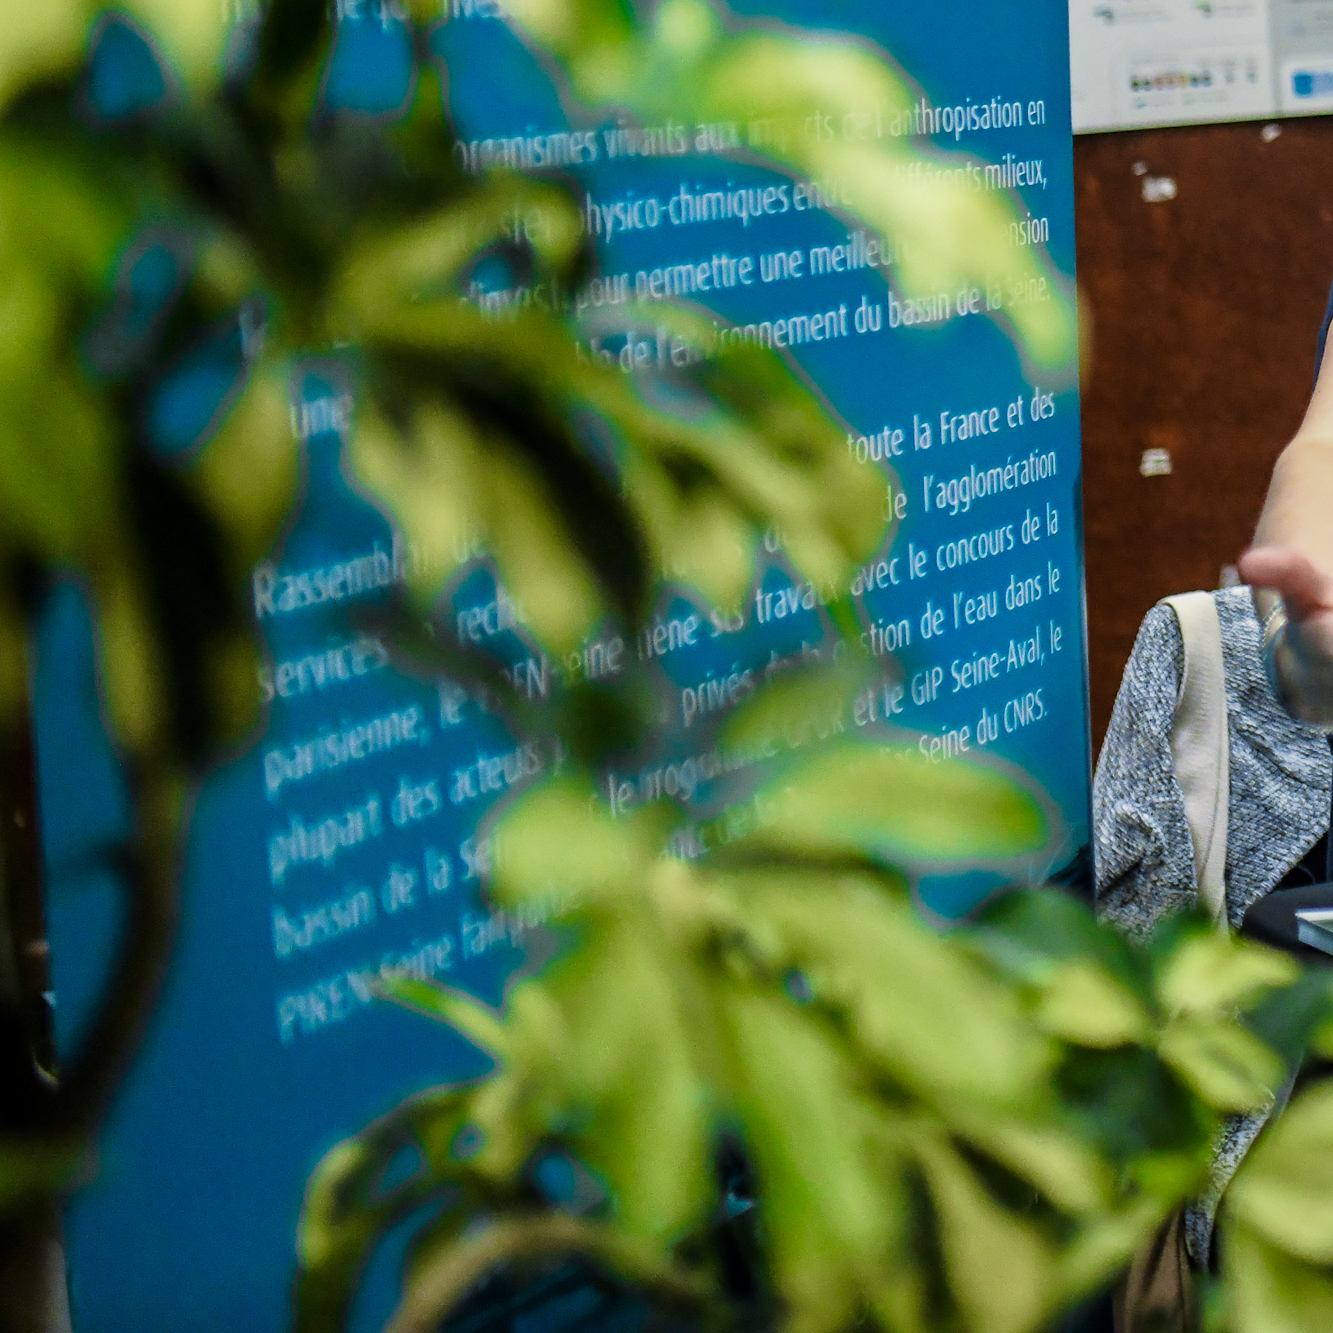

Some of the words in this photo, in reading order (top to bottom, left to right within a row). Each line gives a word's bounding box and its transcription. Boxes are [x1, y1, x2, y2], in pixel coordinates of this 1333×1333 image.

[1026, 98, 1046, 127] en
[584, 179, 789, 244] hysico-chimiques
[984, 153, 1048, 191] milieux,
[635, 252, 754, 300] permettre
[760, 247, 804, 284] une
[854, 295, 883, 335] du
[888, 280, 950, 328] bassin
[956, 281, 980, 318] de
[846, 423, 905, 465] toute
[912, 413, 932, 451] la
[939, 404, 1000, 446] France
[1006, 394, 1025, 429] et
[1029, 384, 1055, 423] des
[258, 634, 389, 703] services
[850, 555, 901, 597] avec
[907, 542, 927, 581] le
[936, 522, 1014, 571] concours
[1020, 507, 1042, 546] de
[1045, 501, 1059, 536] la
[920, 601, 945, 641] de
[1004, 573, 1042, 613] dans
[1048, 560, 1061, 597] le
[390, 776, 442, 827] des
[884, 680, 904, 719] le
[911, 665, 944, 708] GIP
[950, 633, 1046, 694] Seine-Aval,
[1049, 618, 1063, 653] le
[918, 726, 971, 764] Seine
[976, 706, 999, 745] du
[1003, 687, 1048, 734] CNRS.
